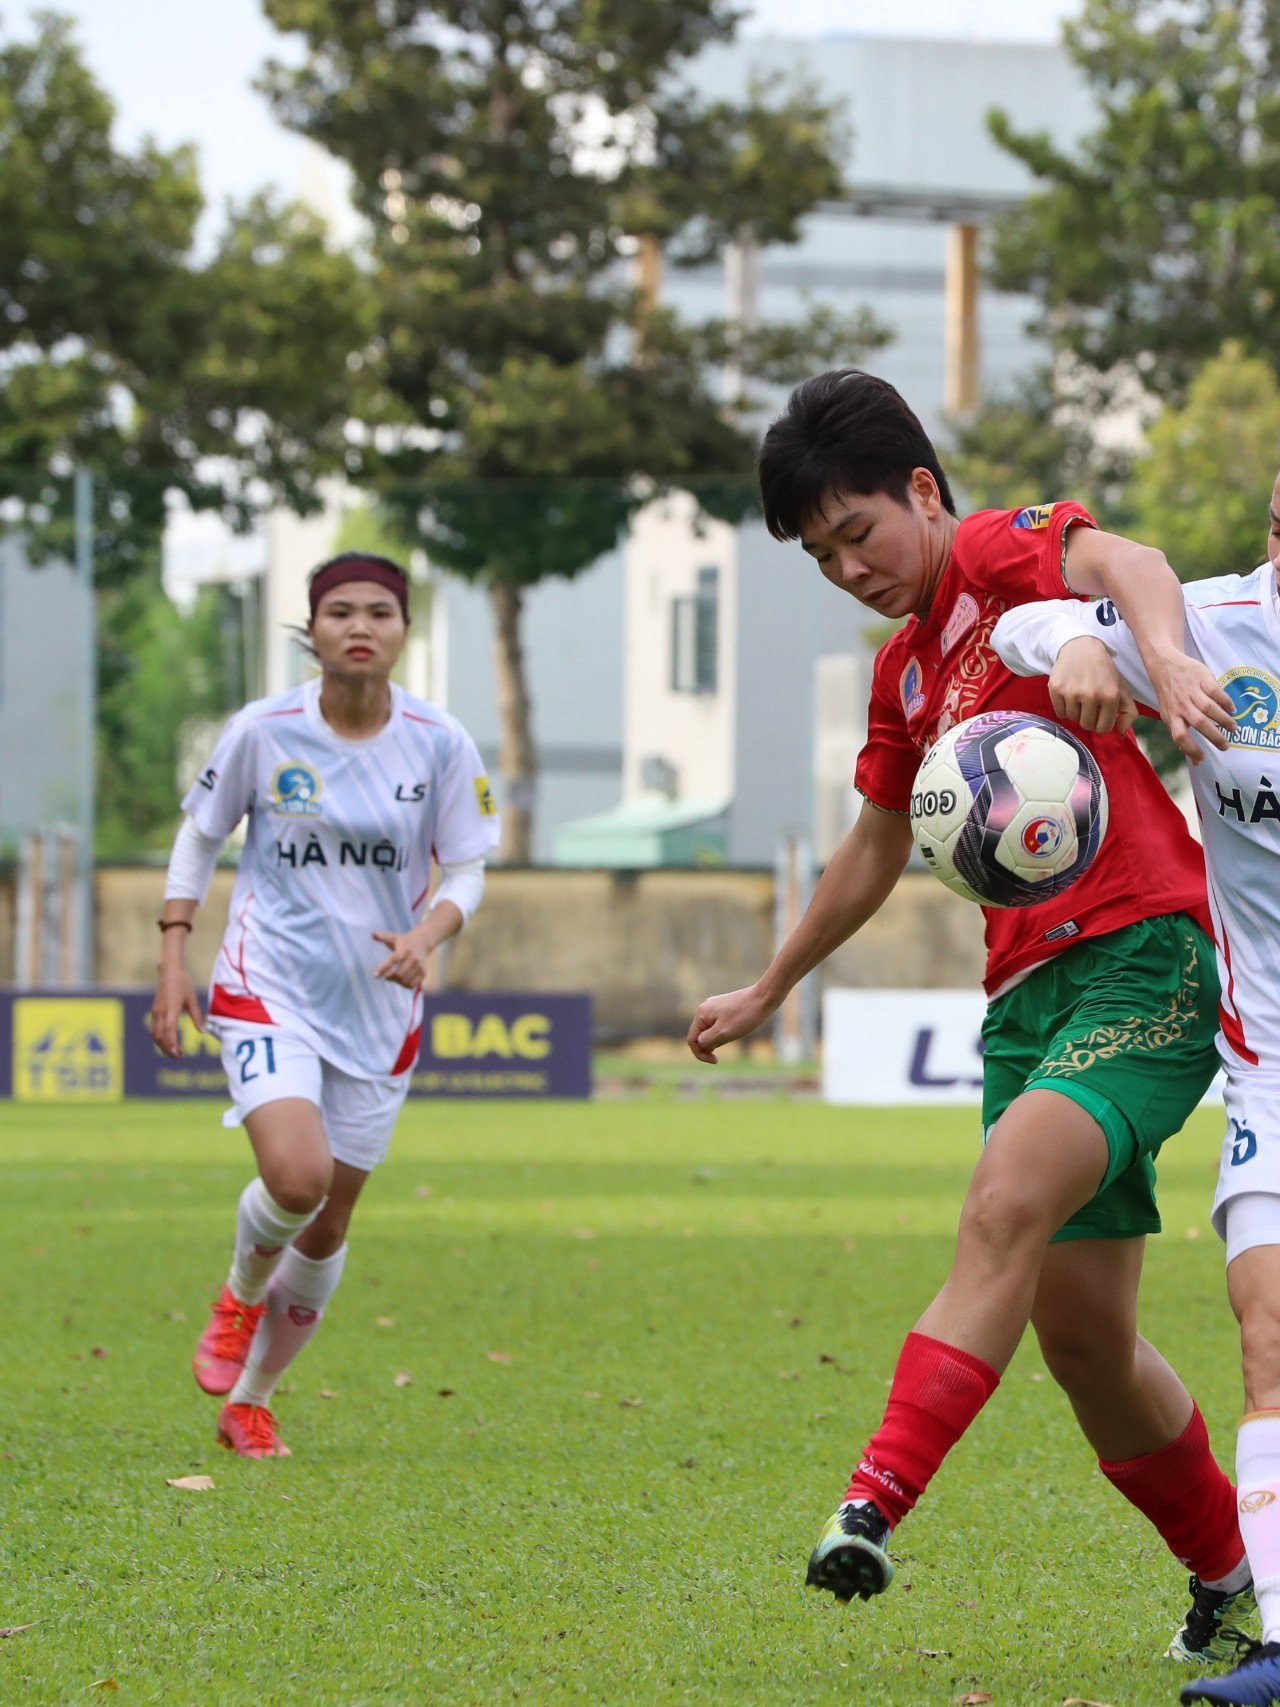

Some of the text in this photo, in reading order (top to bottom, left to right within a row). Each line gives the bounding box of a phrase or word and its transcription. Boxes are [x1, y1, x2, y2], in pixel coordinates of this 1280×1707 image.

[1233, 725, 1259, 745] SƠN
[395, 783, 426, 802] LS
[277, 832, 408, 873] HÀ NỘI
[431, 1012, 554, 1061] BAC
[909, 1028, 985, 1086] L
[234, 1035, 277, 1085] 21
